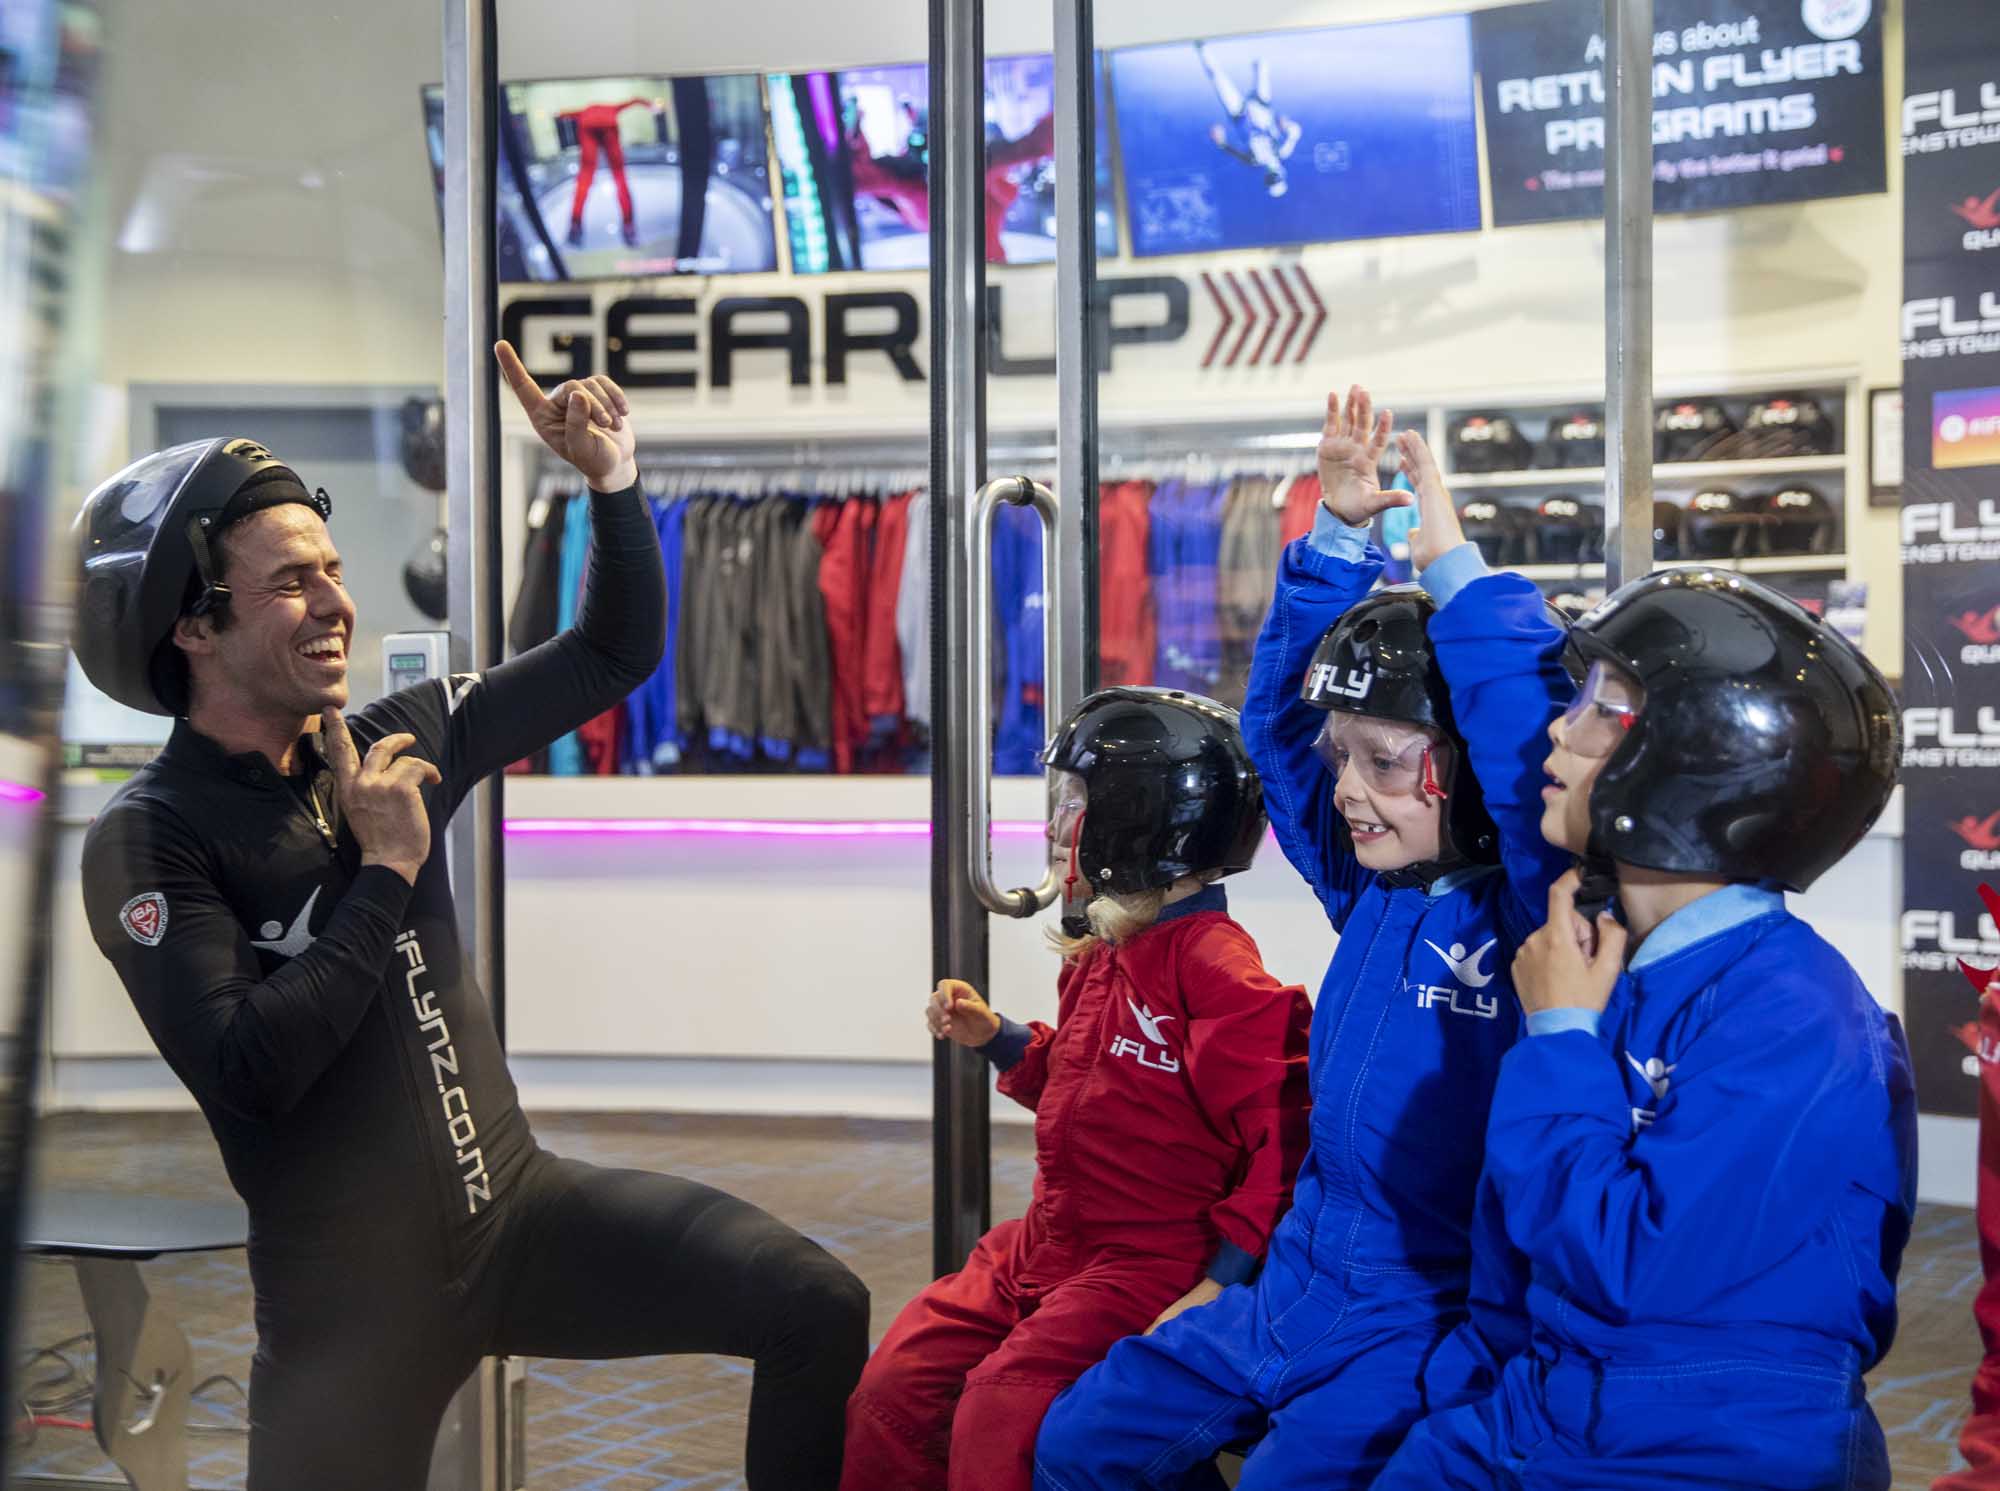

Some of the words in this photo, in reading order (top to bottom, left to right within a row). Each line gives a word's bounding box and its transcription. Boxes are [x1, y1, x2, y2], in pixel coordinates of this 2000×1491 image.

[1681, 16, 1760, 51] about
[1498, 58, 1693, 114] RETN
[1703, 39, 1863, 91] FLYER
[1545, 93, 1817, 154] PRGRAMS
[502, 290, 927, 389] GEAR
[986, 275, 1188, 376] UP
[1309, 663, 1373, 700] iFLY
[1417, 984, 1498, 1019] iFLY
[1109, 1034, 1180, 1073] iFLY
